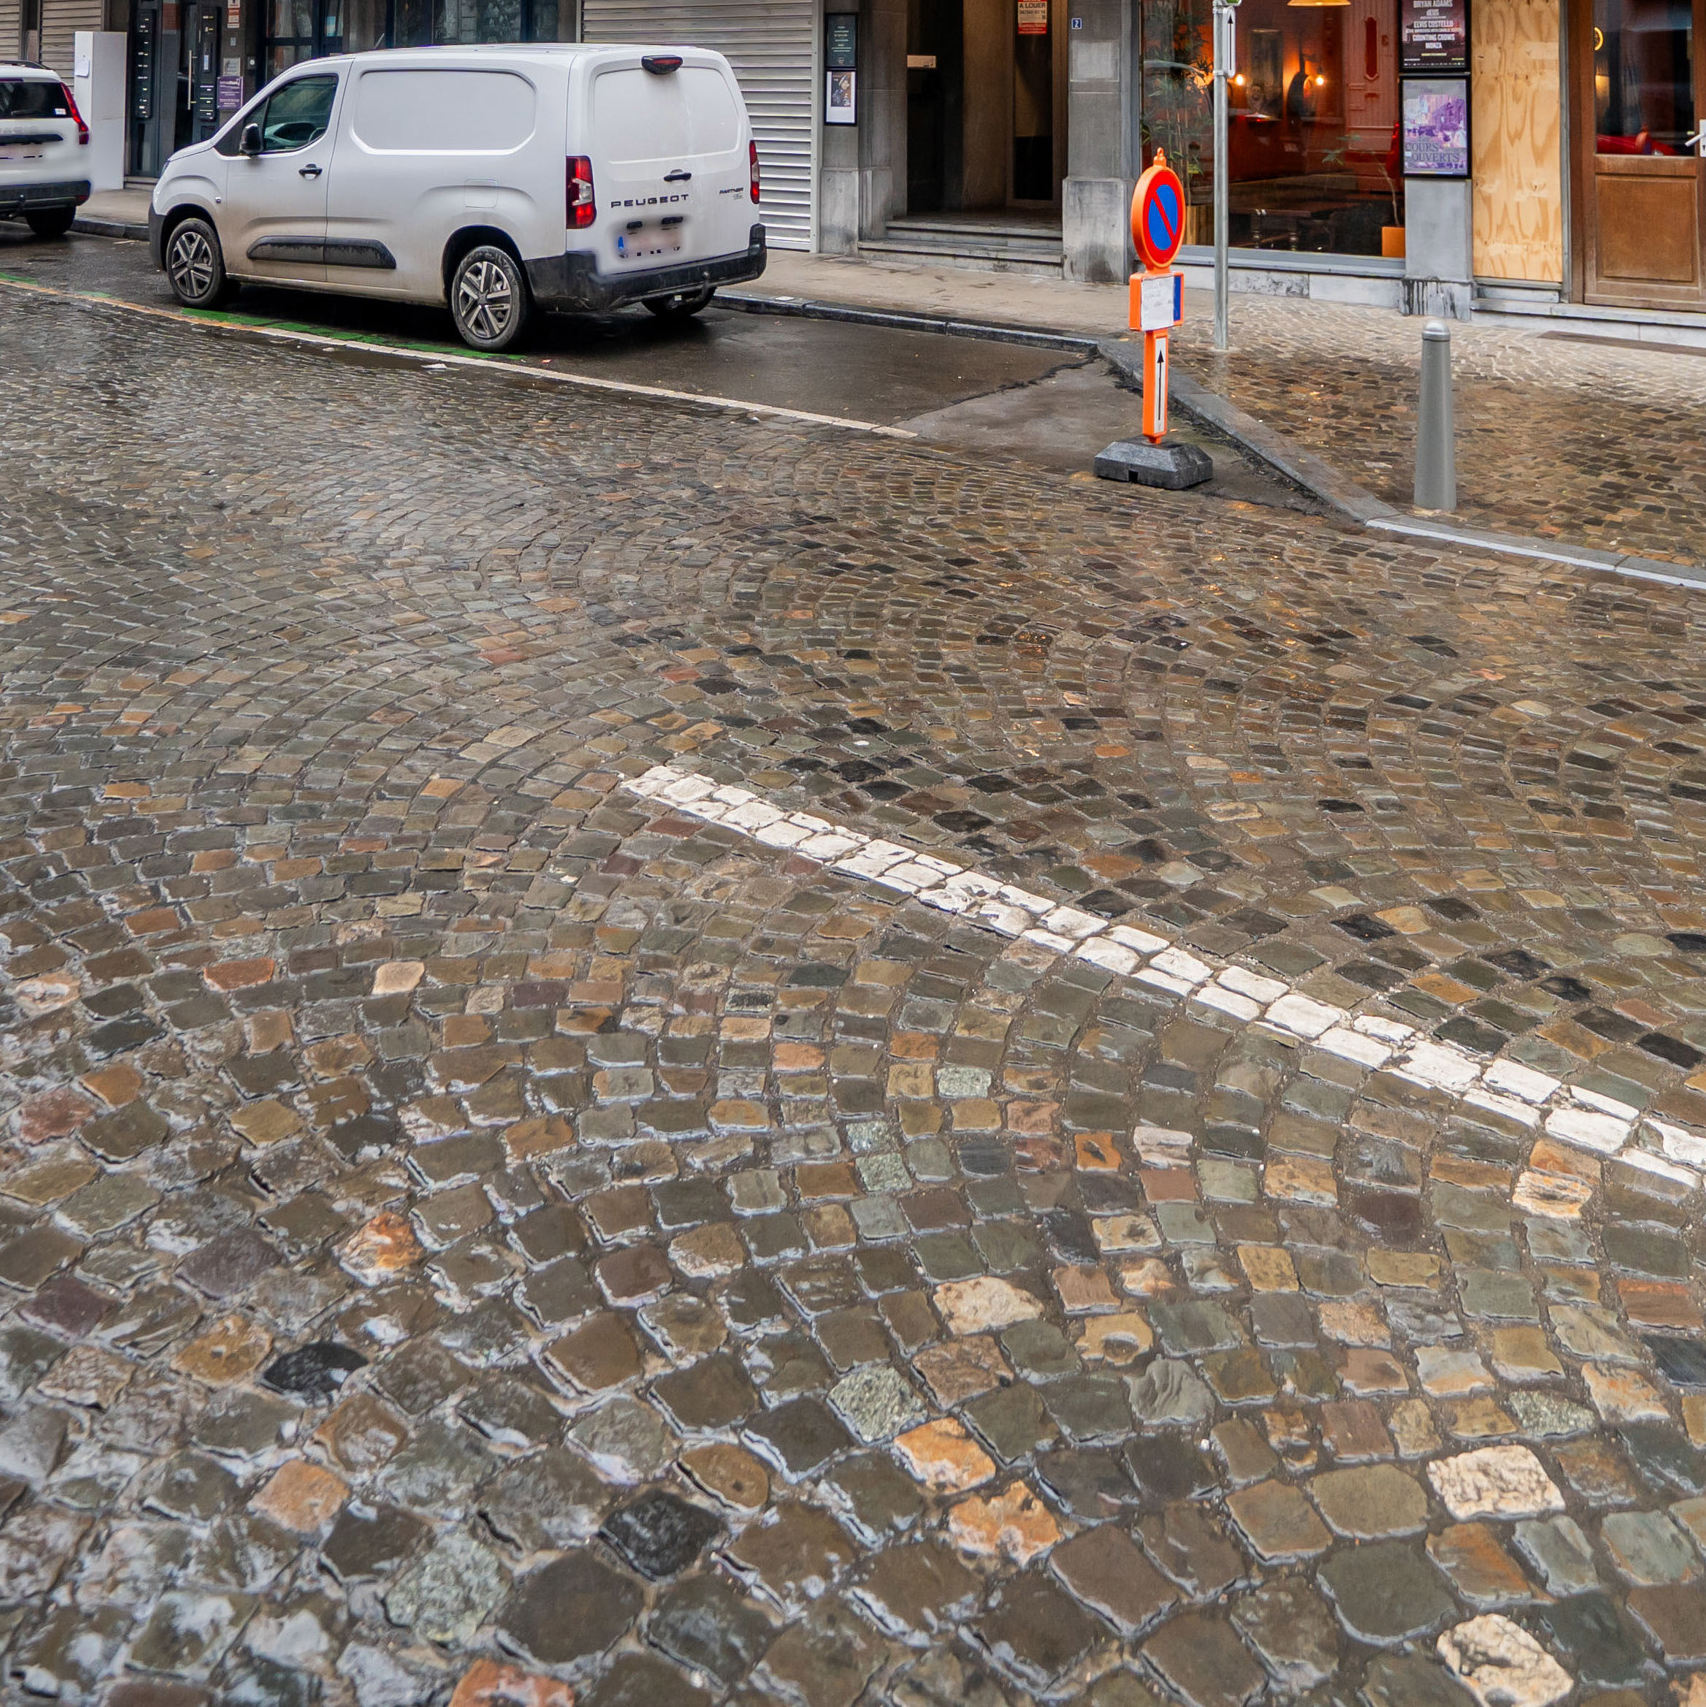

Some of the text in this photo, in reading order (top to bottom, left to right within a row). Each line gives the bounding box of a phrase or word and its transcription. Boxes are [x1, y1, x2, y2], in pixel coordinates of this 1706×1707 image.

[1413, 0, 1432, 8] BRYAN
[1074, 19, 1079, 28] 2
[1405, 142, 1439, 152] COURS
[1412, 154, 1460, 162] OUVERTS
[610, 194, 689, 208] PEUGEOT
